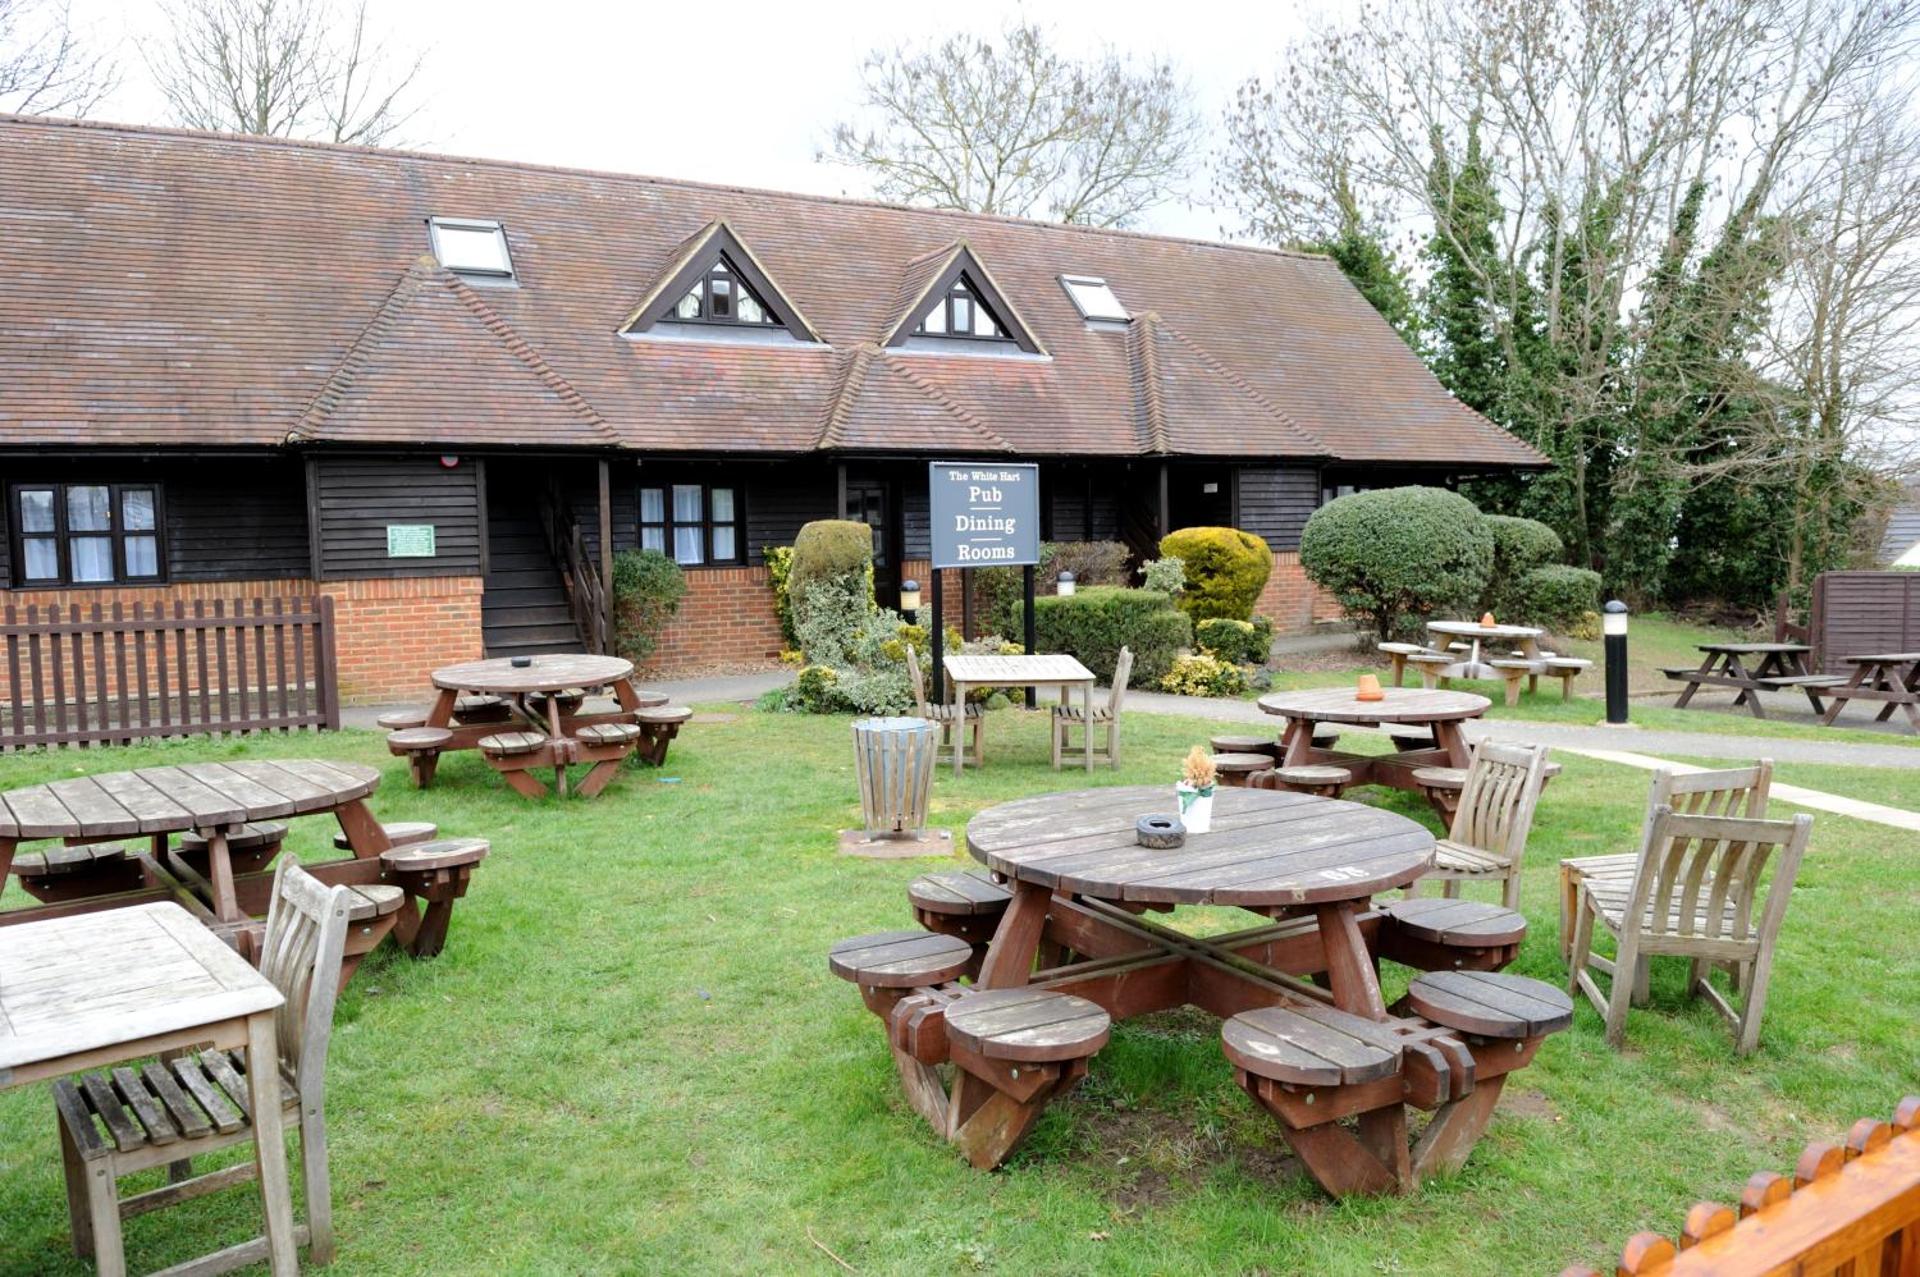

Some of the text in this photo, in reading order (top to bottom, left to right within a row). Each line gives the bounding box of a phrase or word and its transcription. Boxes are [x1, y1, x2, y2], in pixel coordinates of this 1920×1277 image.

[949, 470, 1020, 481] The White Hart
[969, 486, 1002, 502] Pub
[955, 515, 1016, 534] Dining
[958, 544, 1015, 560] Rooms
